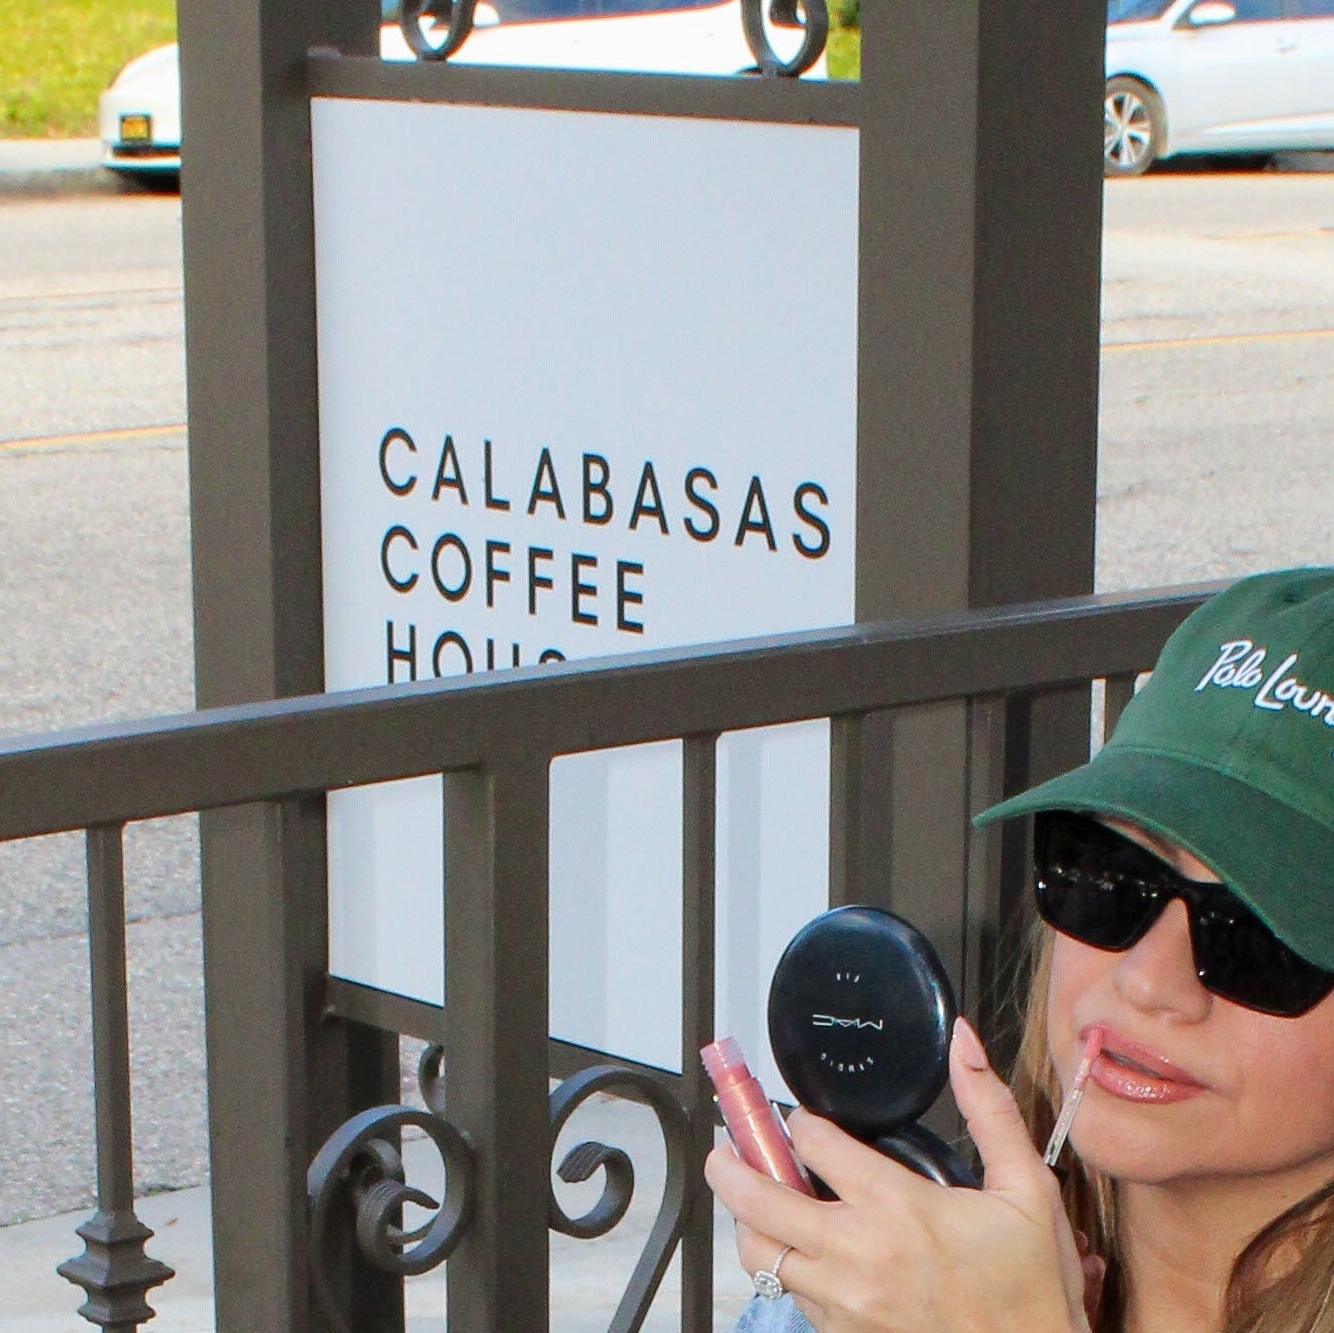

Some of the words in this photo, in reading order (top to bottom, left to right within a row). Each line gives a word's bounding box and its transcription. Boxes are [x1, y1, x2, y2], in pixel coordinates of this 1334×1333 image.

[378, 427, 831, 560] CALABASAS
[380, 524, 644, 634] COFFEE
[1194, 638, 1267, 691] Polo
